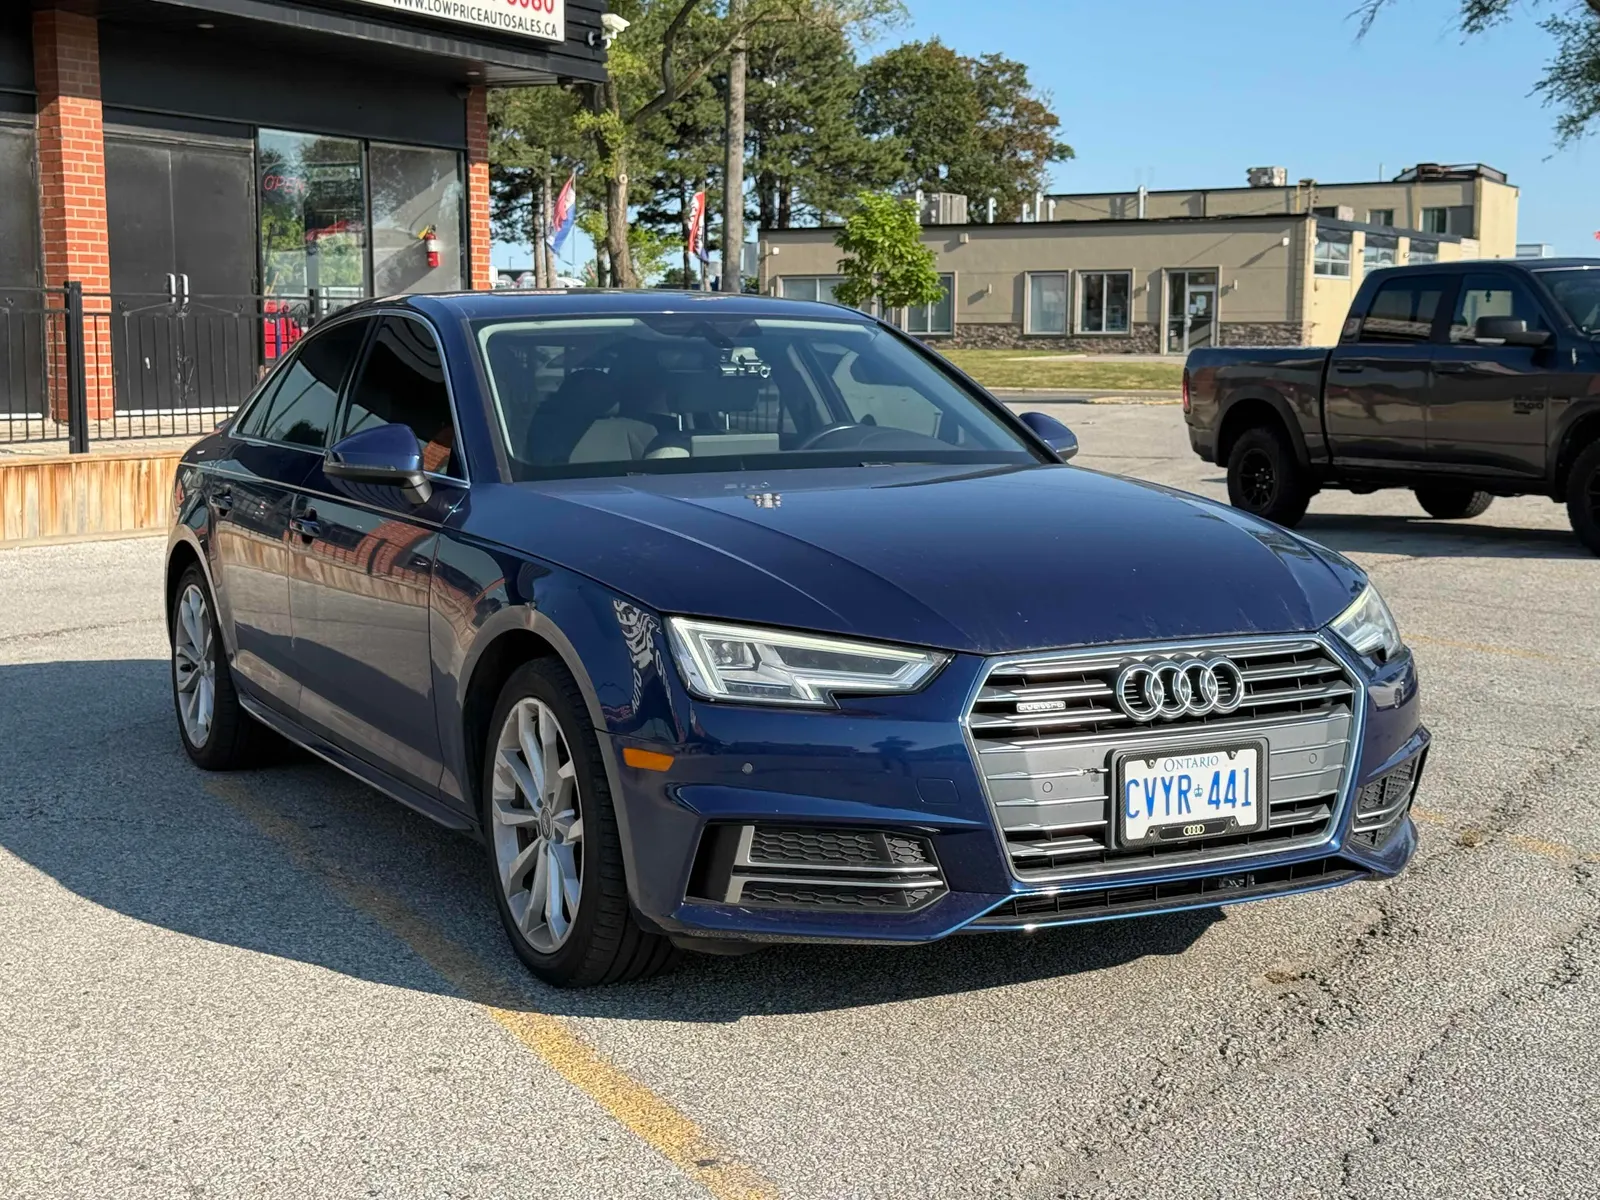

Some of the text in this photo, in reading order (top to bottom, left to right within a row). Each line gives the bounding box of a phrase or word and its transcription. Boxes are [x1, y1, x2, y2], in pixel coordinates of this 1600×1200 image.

[1164, 756, 1219, 772] ONTARIO
[1125, 767, 1252, 819] CVYR 441
